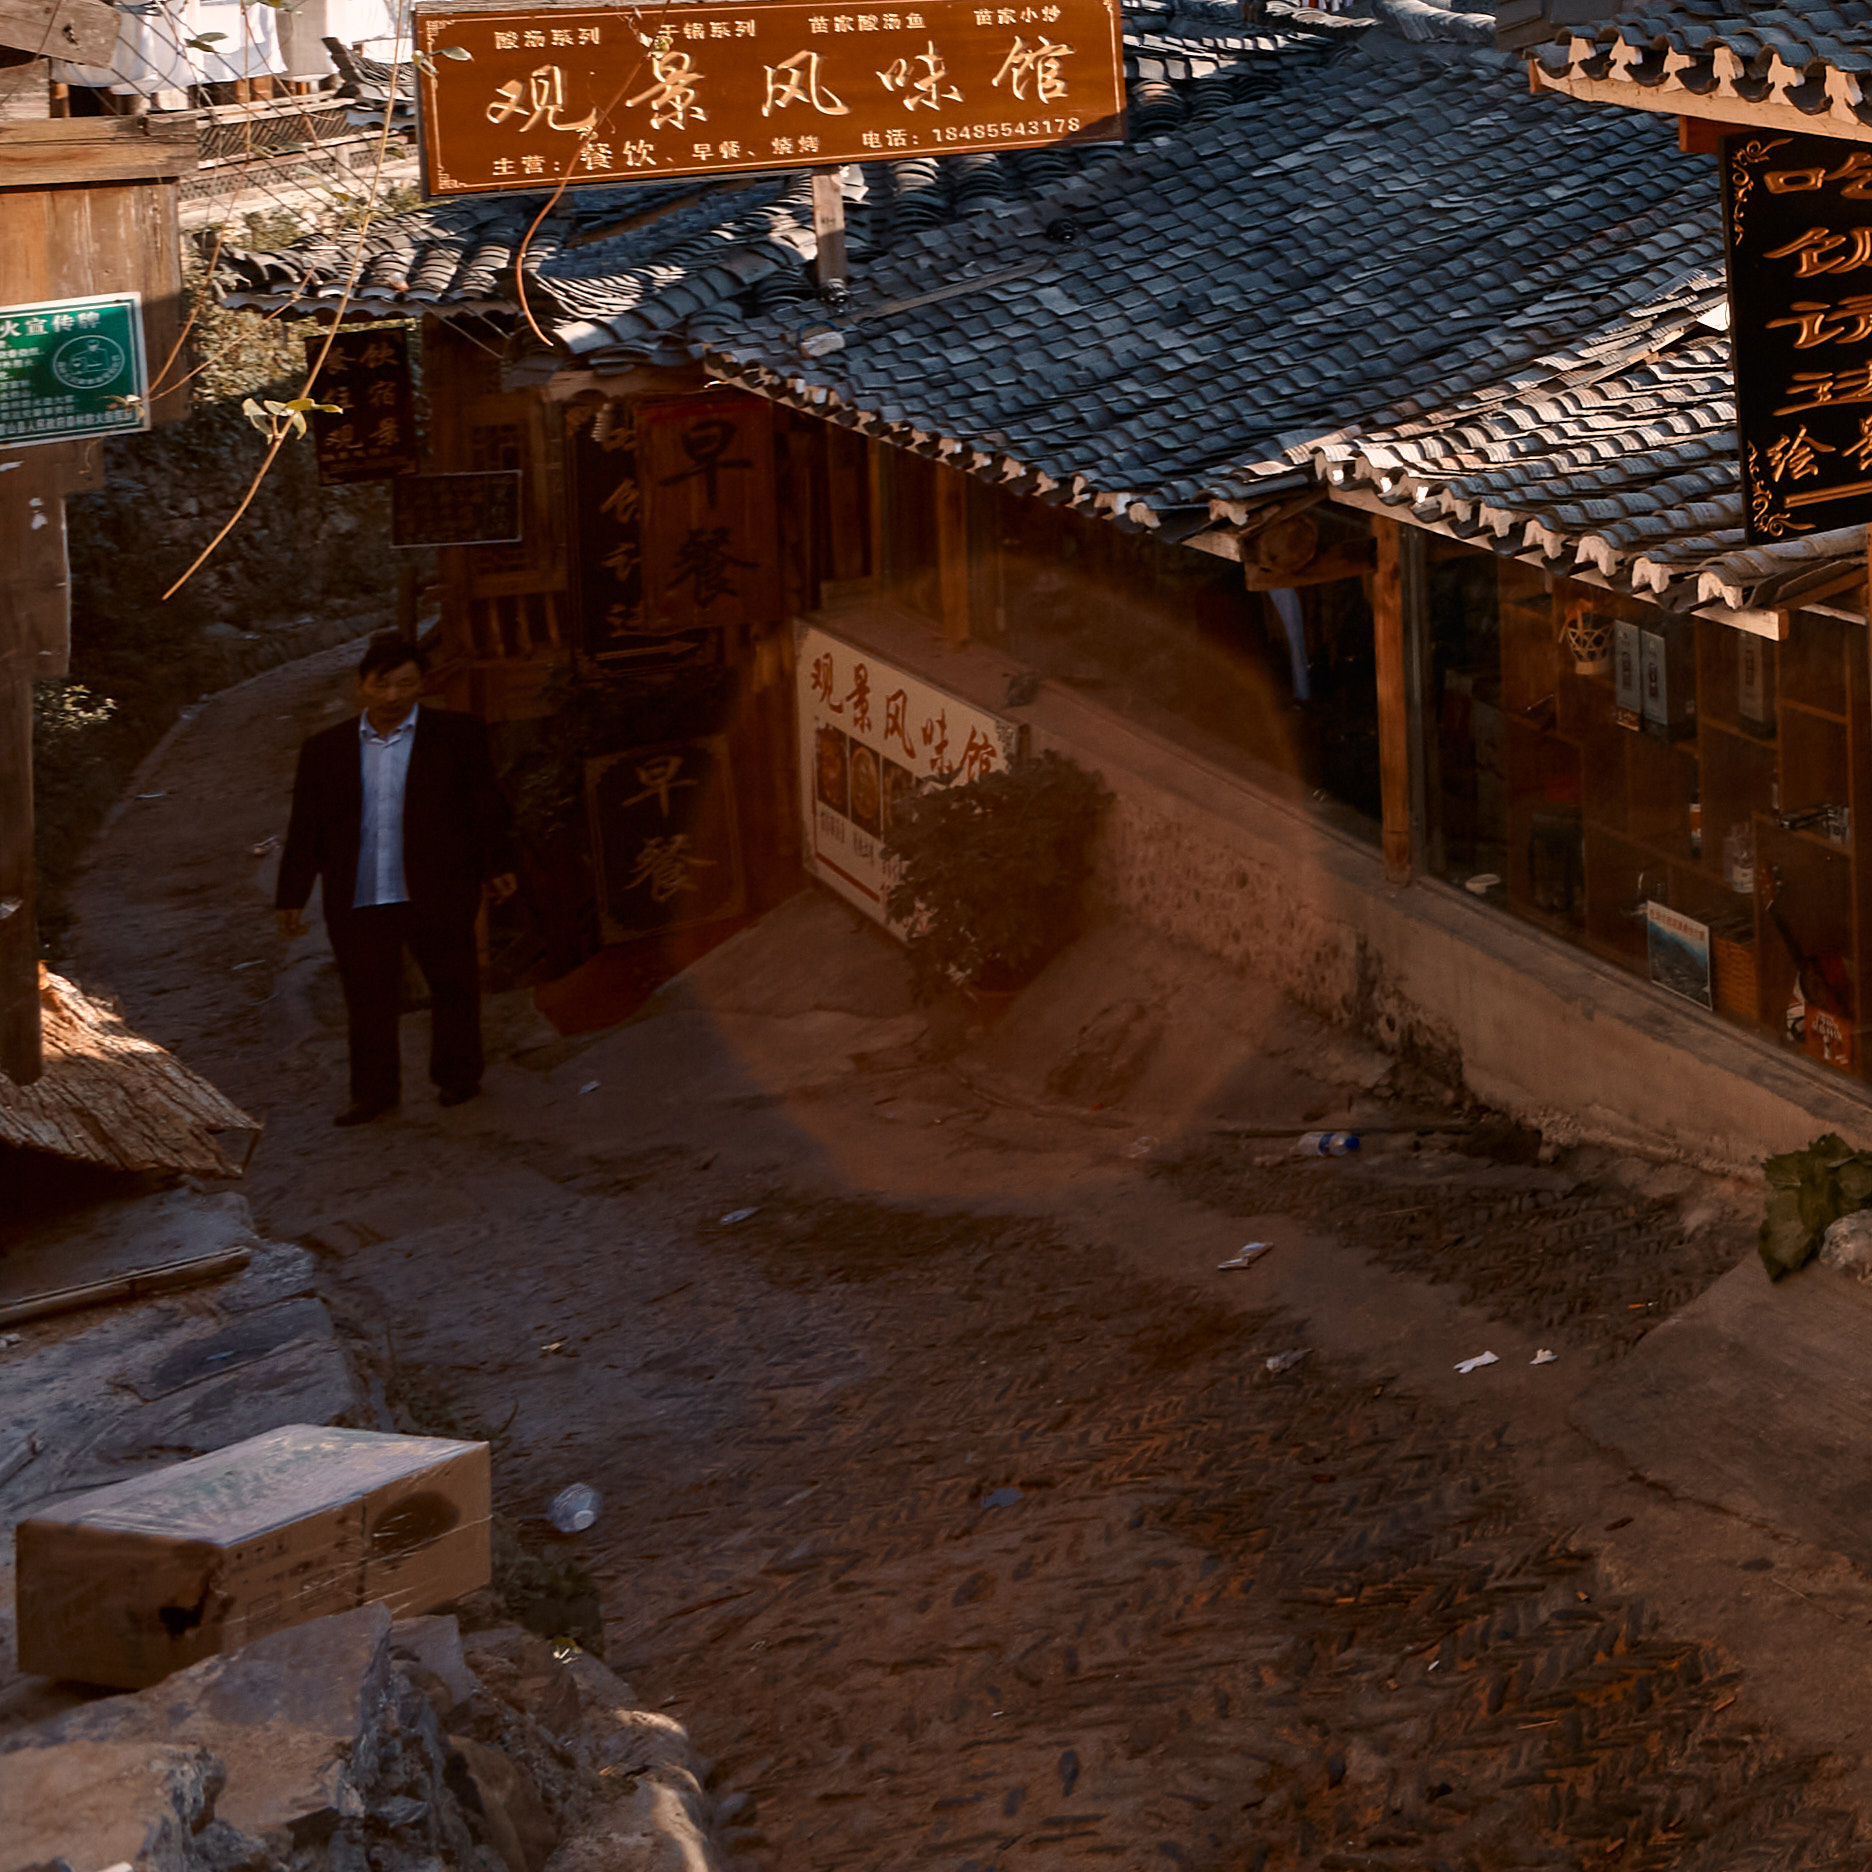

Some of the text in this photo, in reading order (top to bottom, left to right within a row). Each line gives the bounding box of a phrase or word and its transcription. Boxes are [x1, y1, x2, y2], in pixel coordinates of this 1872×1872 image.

[486, 35, 1076, 132] 观景风味馆
[808, 12, 927, 34] 苗家酸汤鱼
[973, 4, 1062, 26] 苗家小炒
[659, 419, 760, 608] 早餐
[811, 652, 997, 781] 观景风味馆
[620, 756, 718, 903] 早餐
